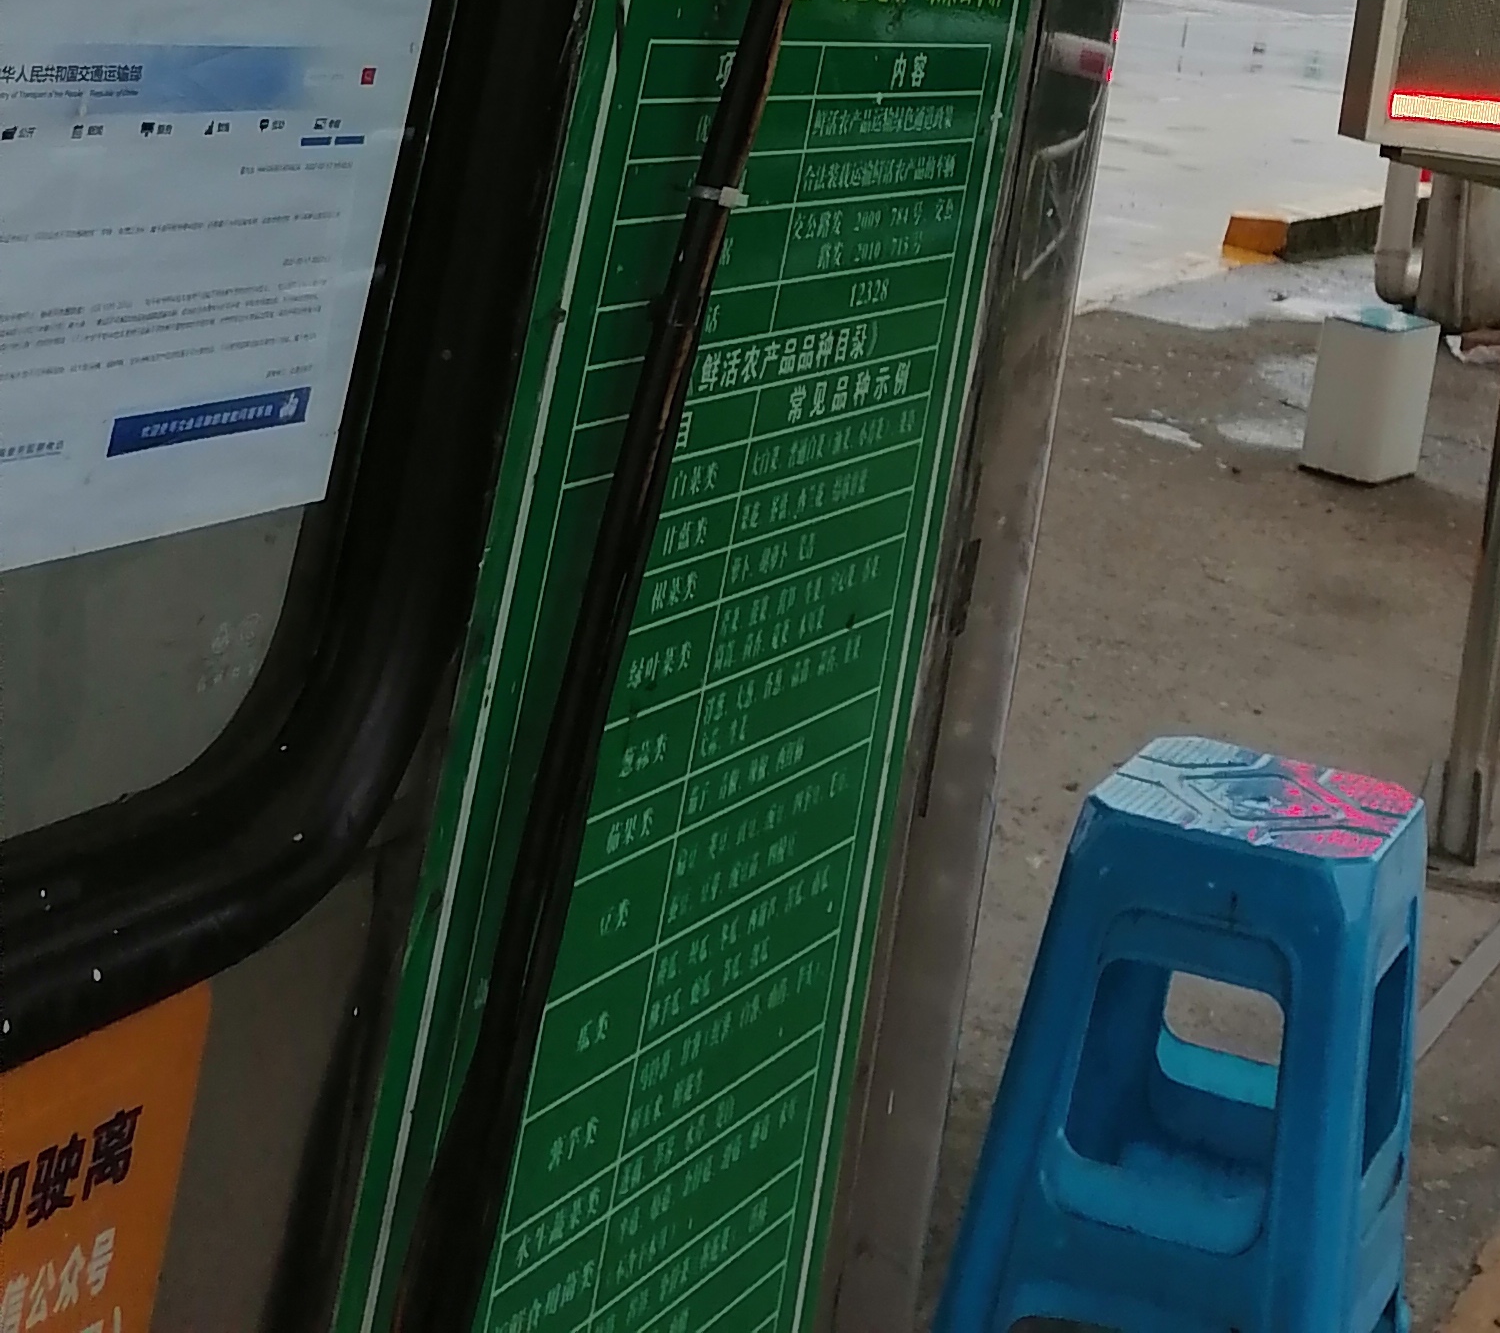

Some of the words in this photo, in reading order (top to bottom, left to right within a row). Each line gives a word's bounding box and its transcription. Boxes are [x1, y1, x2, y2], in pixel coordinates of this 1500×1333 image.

[0, 64, 143, 84] 华人民共和国交通运输部
[891, 51, 928, 89] 内容
[849, 277, 889, 308] 12328
[787, 358, 911, 425] 常见品种示例
